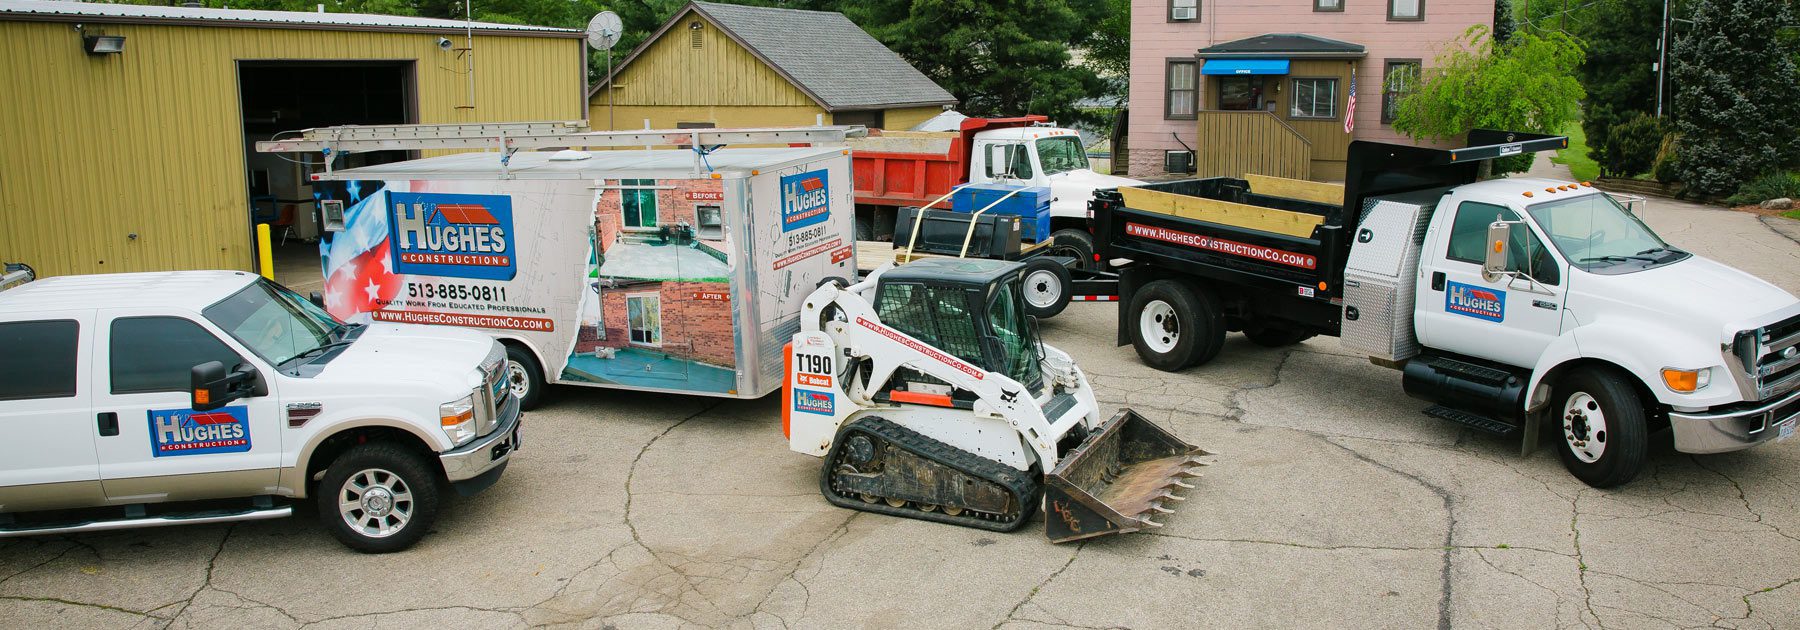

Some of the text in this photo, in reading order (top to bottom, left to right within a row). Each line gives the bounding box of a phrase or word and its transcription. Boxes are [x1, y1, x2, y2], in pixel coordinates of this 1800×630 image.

[785, 181, 826, 215] HUGHES
[396, 203, 507, 253] HUGHES
[410, 254, 499, 265] CONSTRUCTION
[408, 283, 507, 302] 513-885-0811
[1450, 285, 1501, 313] HUGHES
[1453, 305, 1497, 317] CONSTRUCTION
[796, 353, 832, 375] T190
[808, 376, 830, 387] Bobcat
[797, 391, 833, 409] HUGHES
[156, 415, 244, 443] HUGHES
[168, 440, 239, 450] CONSTRUCTION
